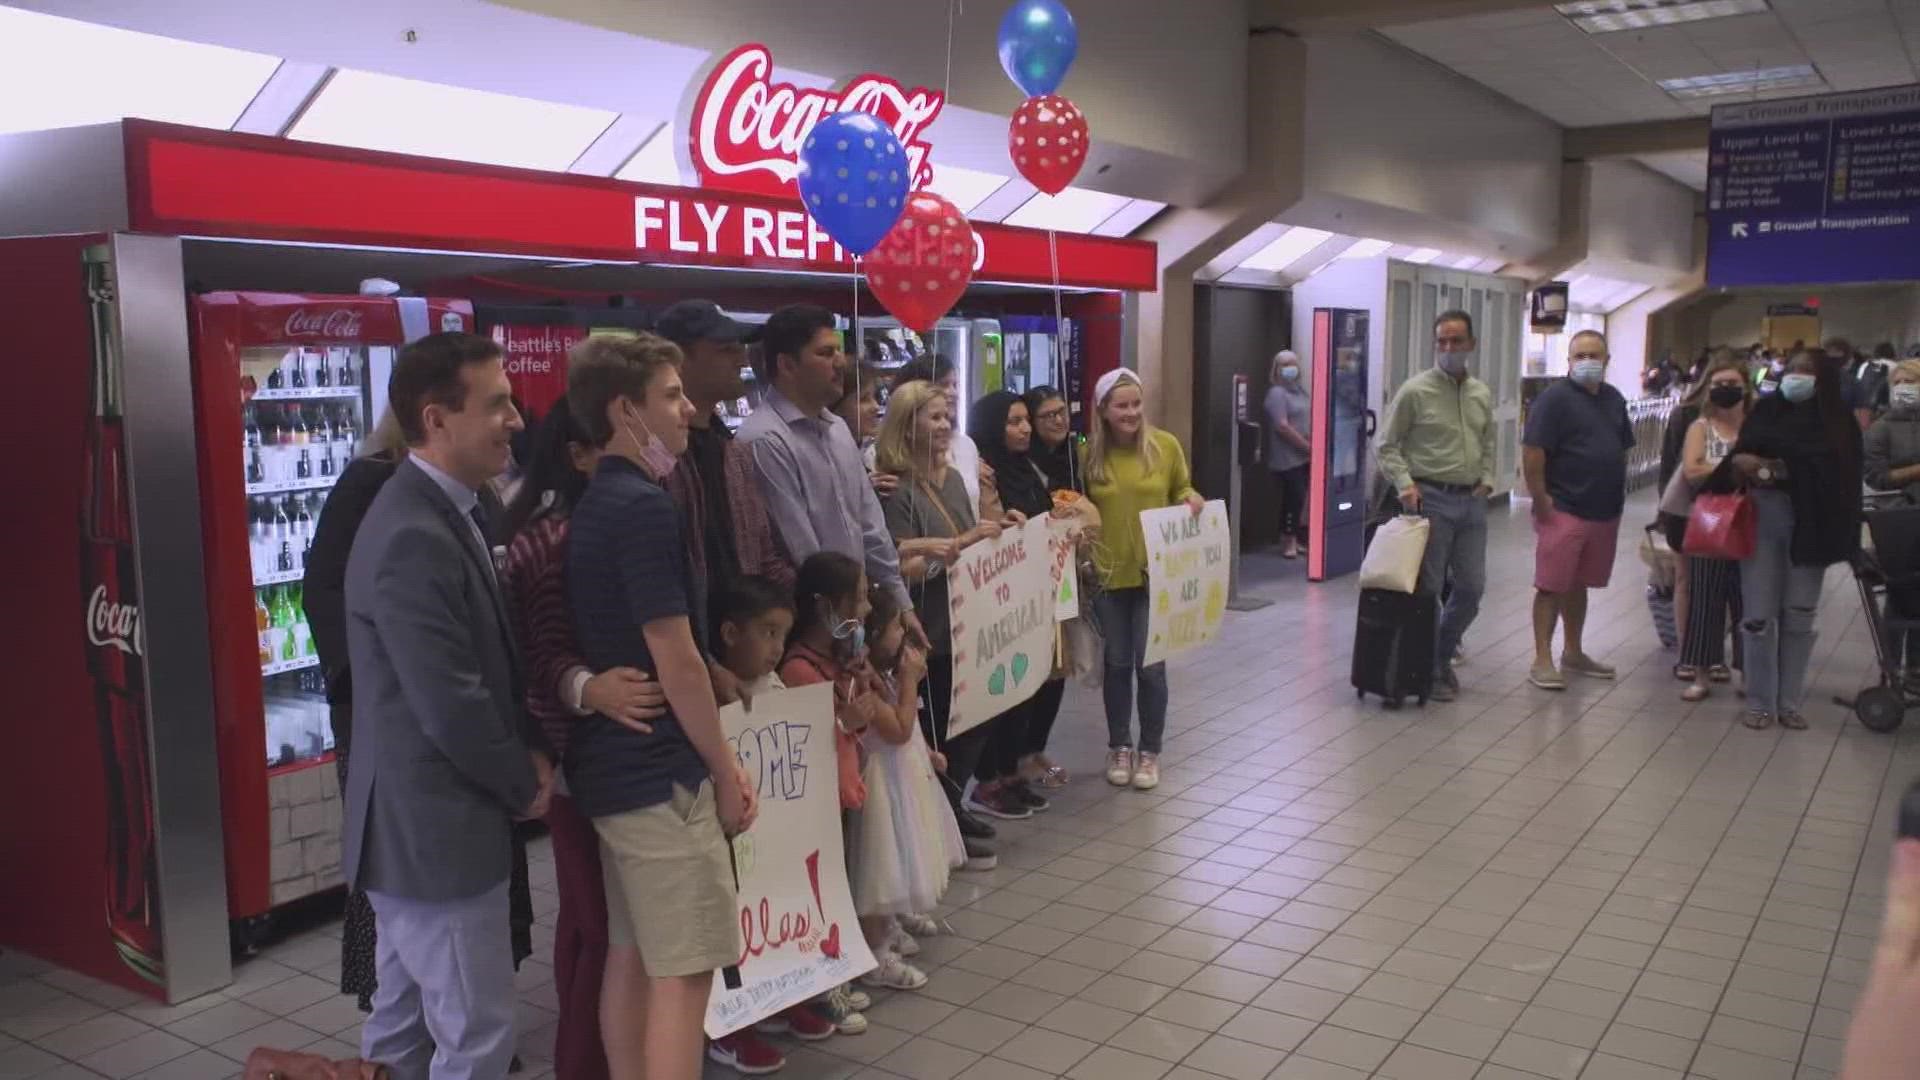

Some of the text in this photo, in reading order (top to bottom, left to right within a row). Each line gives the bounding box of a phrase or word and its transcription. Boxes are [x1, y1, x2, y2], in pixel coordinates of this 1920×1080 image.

[634, 195, 730, 253] FLY
[1774, 215, 1910, 232] Ground Transportation
[284, 309, 363, 338] Coca-Cola
[966, 542, 1028, 592] WELCOME
[995, 582, 1011, 606] TO
